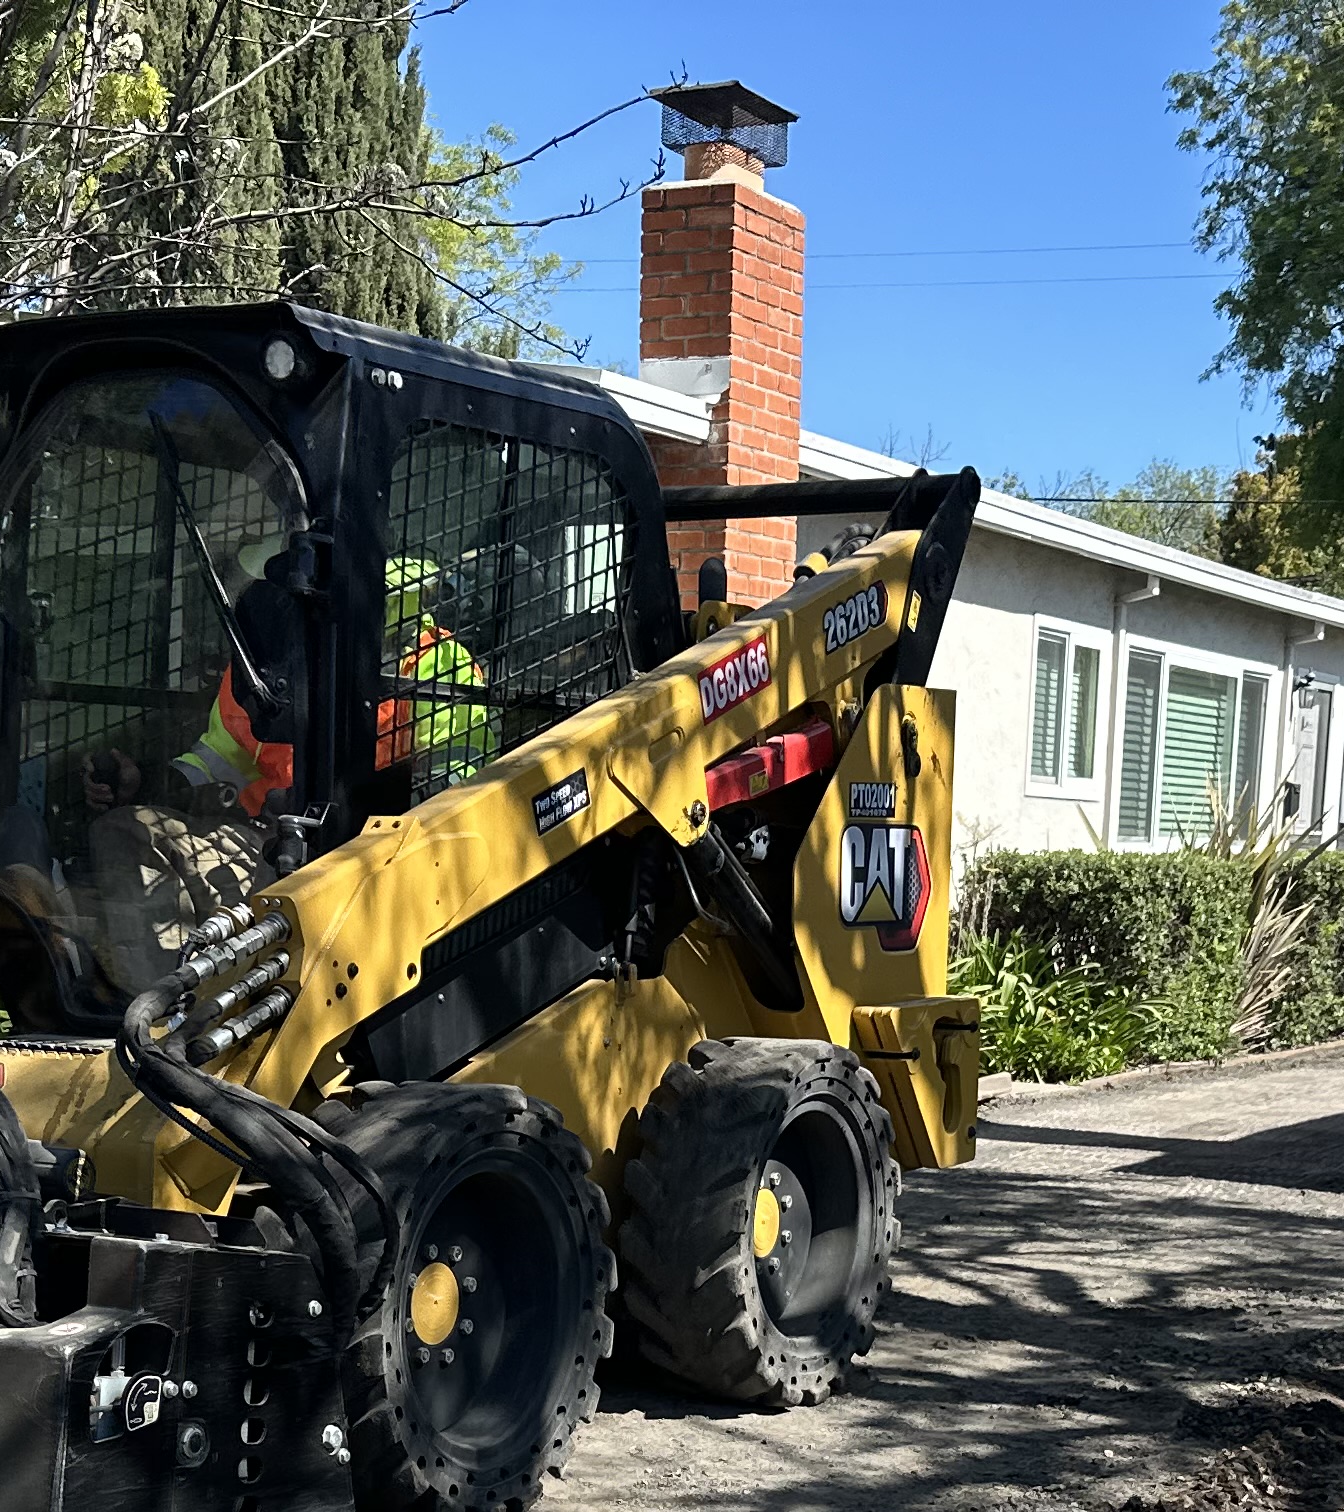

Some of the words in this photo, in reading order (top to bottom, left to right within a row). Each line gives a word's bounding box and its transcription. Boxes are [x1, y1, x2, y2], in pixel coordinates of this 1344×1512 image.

[824, 586, 880, 652] 262D3
[700, 642, 769, 718] DG8X66
[841, 826, 911, 922] CAT
